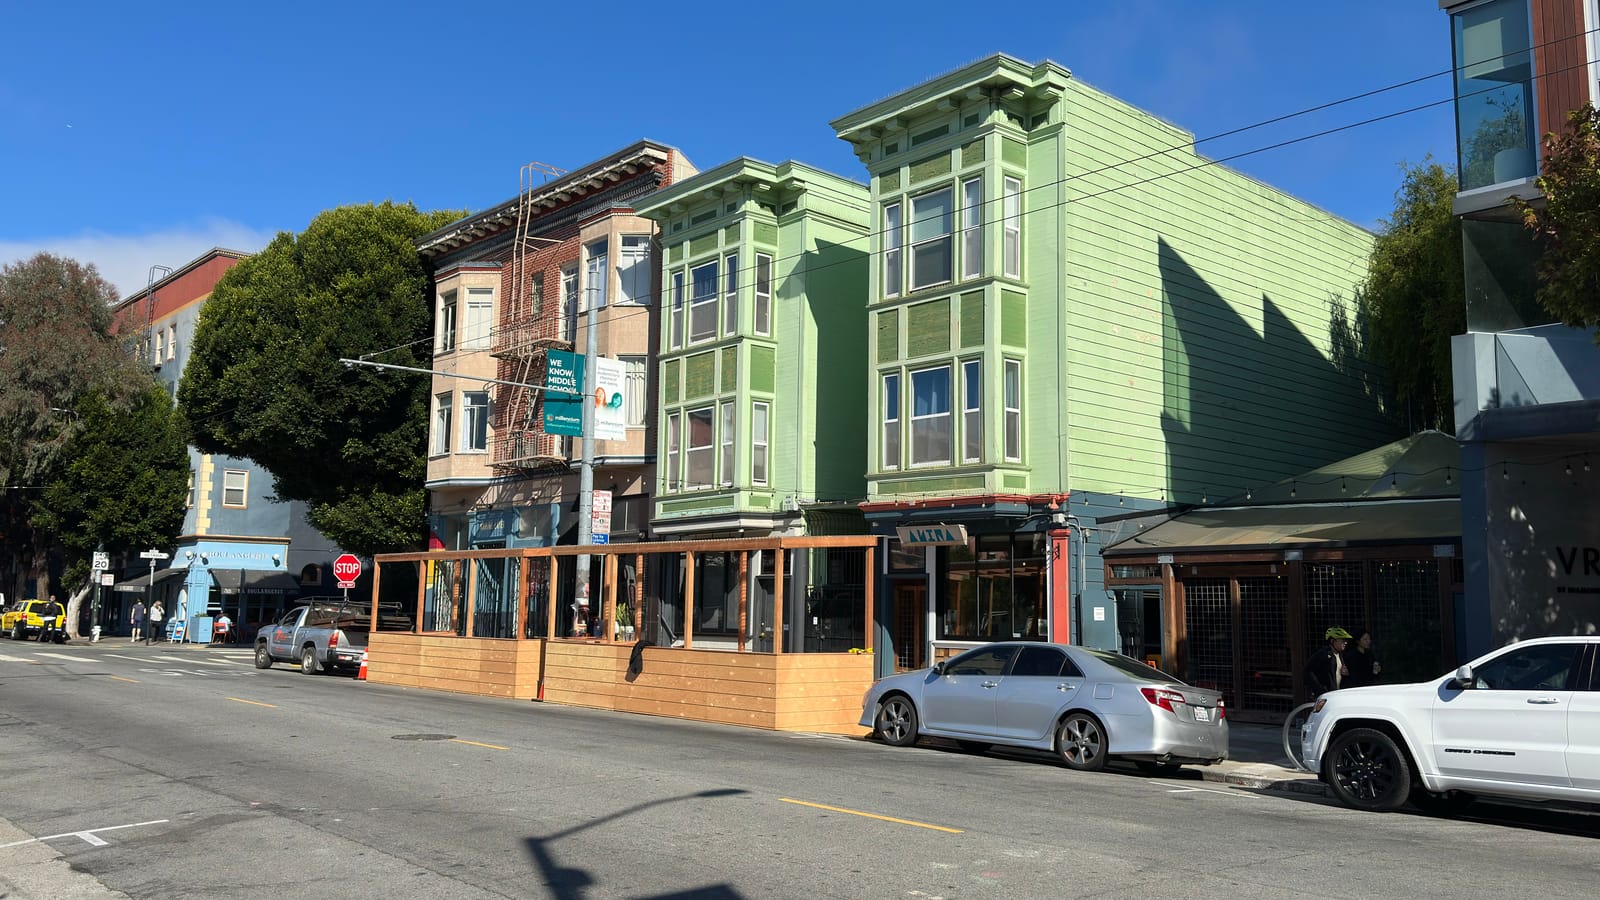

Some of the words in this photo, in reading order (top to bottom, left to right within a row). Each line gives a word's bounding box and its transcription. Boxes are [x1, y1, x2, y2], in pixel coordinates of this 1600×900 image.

[550, 359, 562, 367] WE
[548, 377, 577, 386] MIDDLE
[94, 560, 108, 569] 20
[335, 562, 360, 574] STOP
